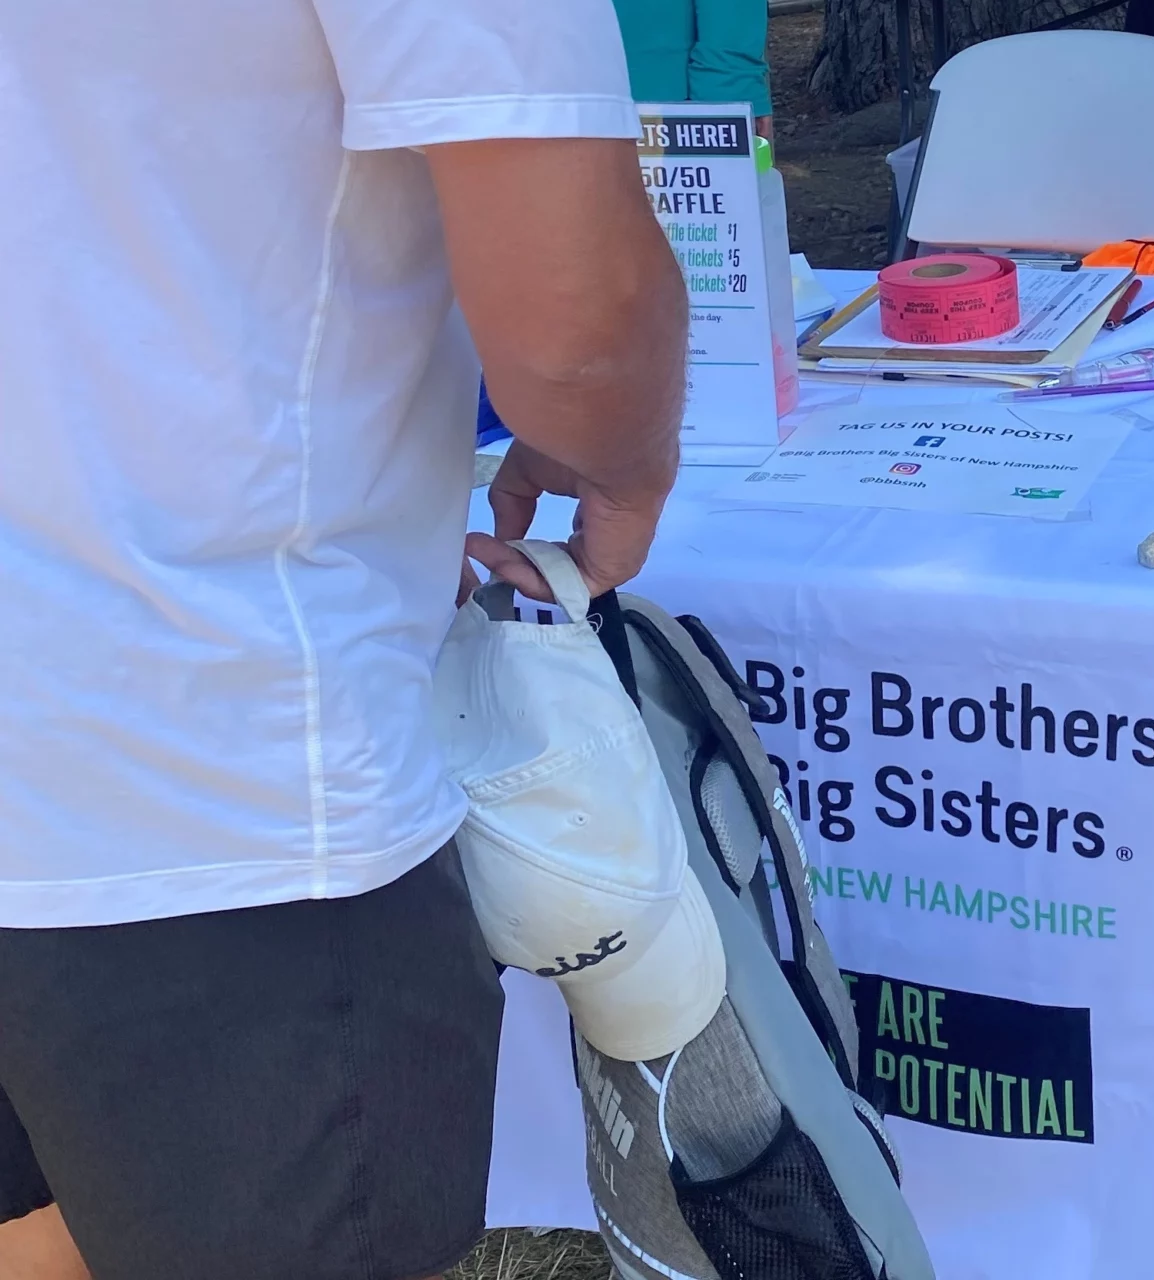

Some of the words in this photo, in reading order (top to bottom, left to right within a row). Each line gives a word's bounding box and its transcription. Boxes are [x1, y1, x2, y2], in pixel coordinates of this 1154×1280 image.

[675, 123, 738, 148] HERE!
[641, 165, 711, 189] 50/50
[687, 222, 718, 242] ticket
[728, 222, 738, 243] $1
[688, 248, 724, 268] tickets
[728, 248, 740, 268] $5
[690, 273, 727, 293] tickets
[728, 273, 747, 293] $20
[690, 313, 705, 321] the
[837, 421, 875, 431] TAG
[880, 421, 907, 430] US
[910, 421, 936, 431] IN
[938, 422, 997, 436] YOUR
[999, 427, 1074, 443] POSTS!
[816, 448, 876, 457] Brothers
[877, 449, 900, 459] Big
[902, 449, 947, 461] Sisters
[949, 454, 968, 464] of
[967, 457, 1001, 467] New
[1002, 460, 1079, 472] Hampshire
[859, 476, 927, 489] @bbbsnh
[745, 659, 851, 753] Big
[812, 863, 893, 903] NEW
[904, 874, 1118, 940] HAMPSHIRE
[877, 980, 949, 1050] ARE
[875, 1048, 1086, 1138] POTENTIAL
